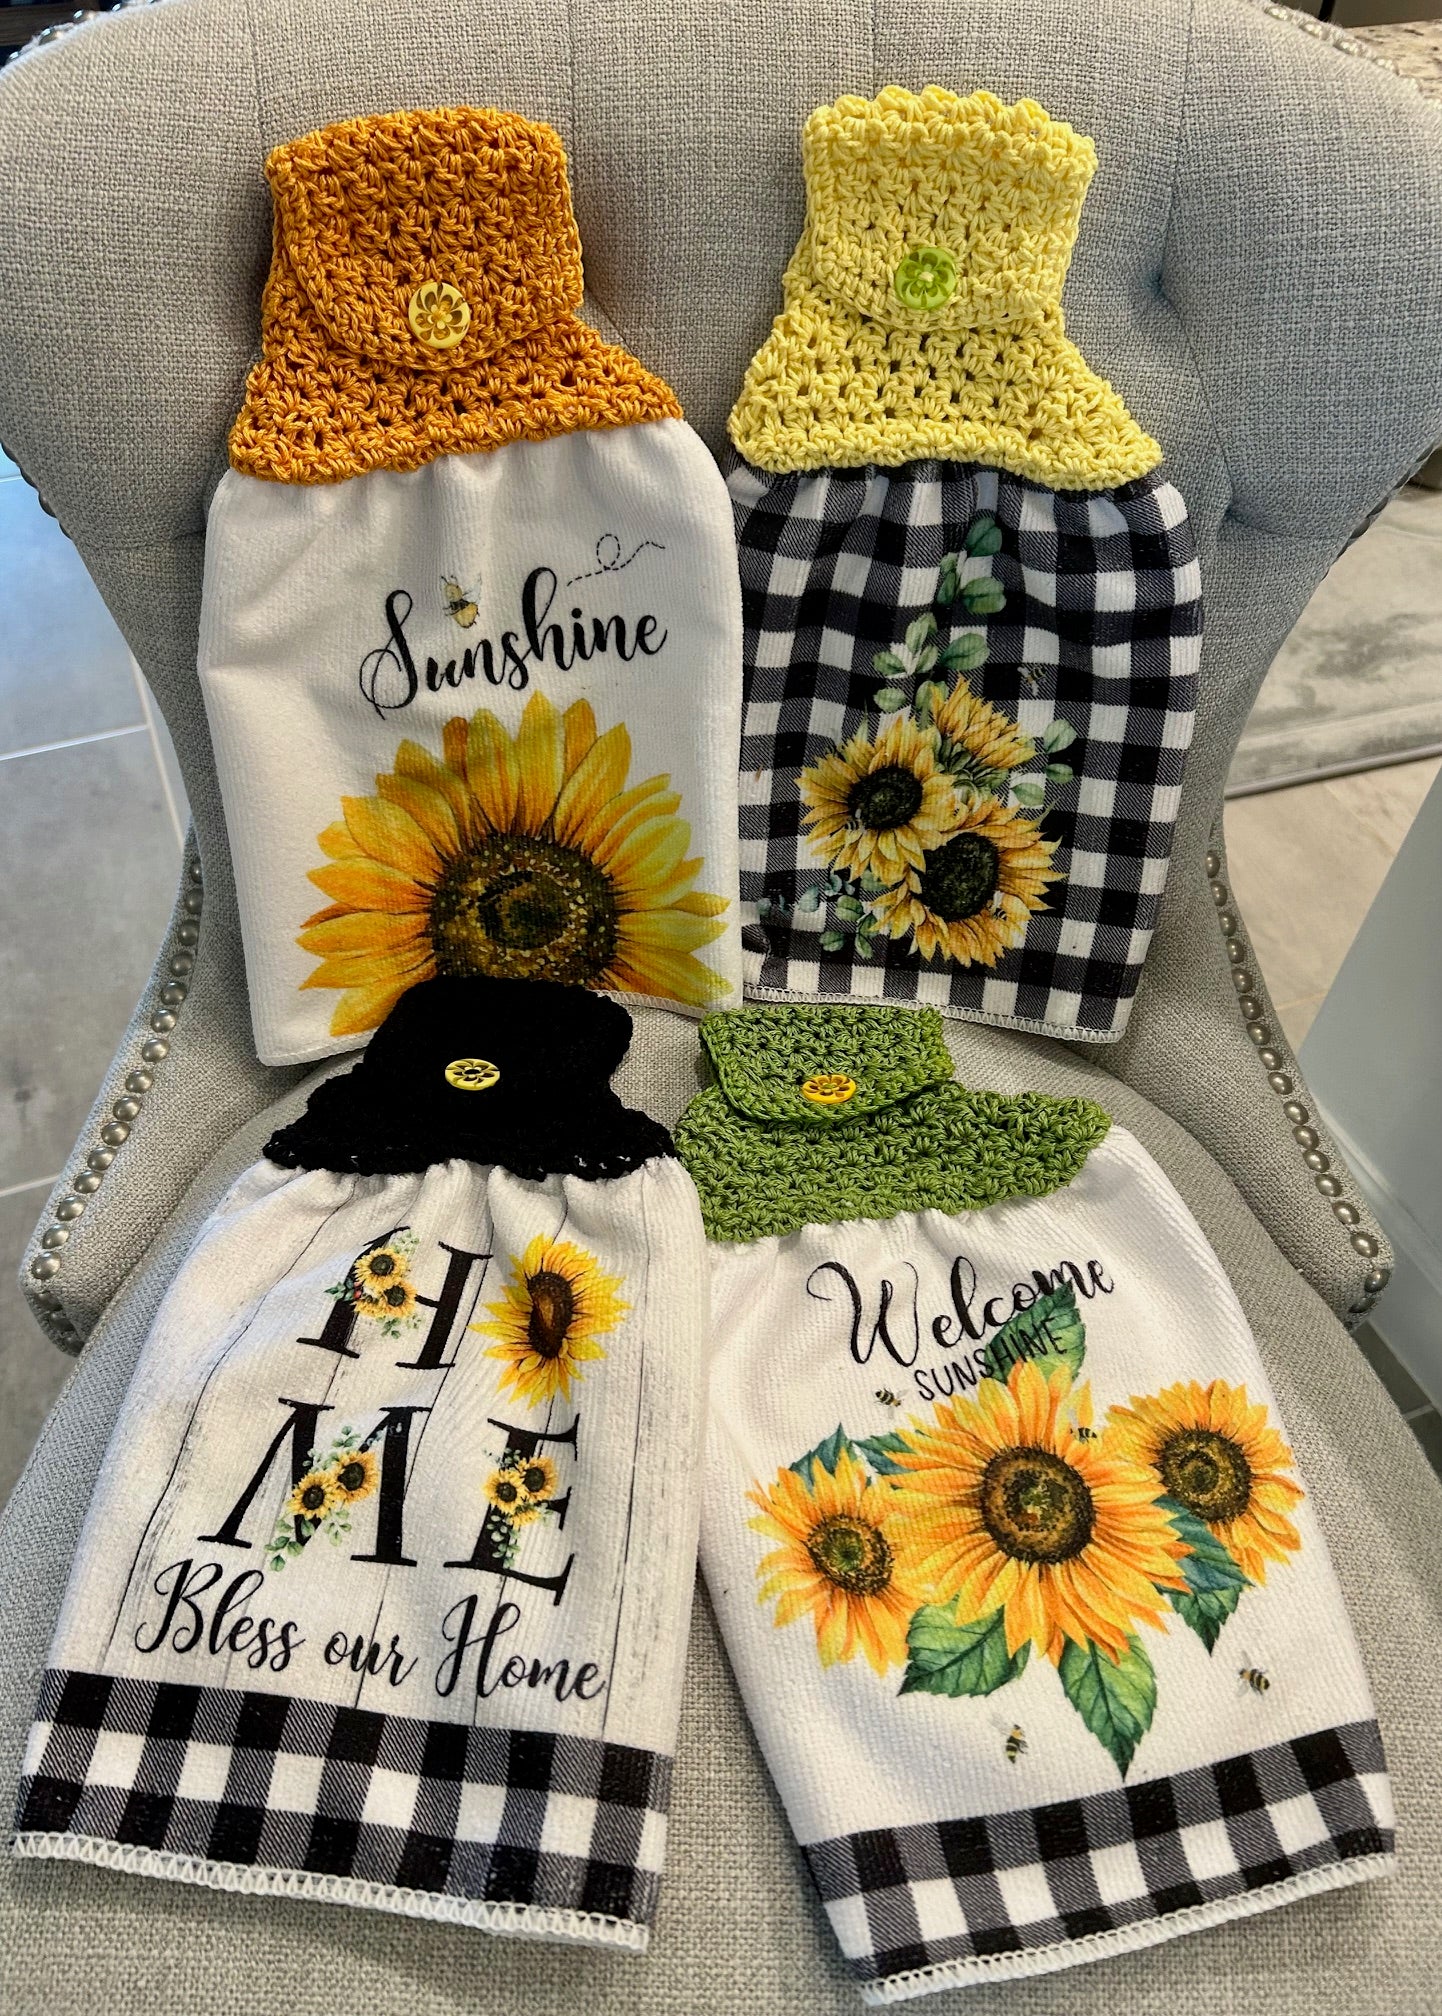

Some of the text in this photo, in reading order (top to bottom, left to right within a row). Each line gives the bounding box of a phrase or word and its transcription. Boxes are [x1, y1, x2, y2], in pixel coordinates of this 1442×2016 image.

[360, 566, 668, 720] Sunshine
[806, 1256, 1115, 1367] Welcome
[914, 1317, 1067, 1401] SUNSHINE
[134, 1557, 607, 1704] Bless our Home
